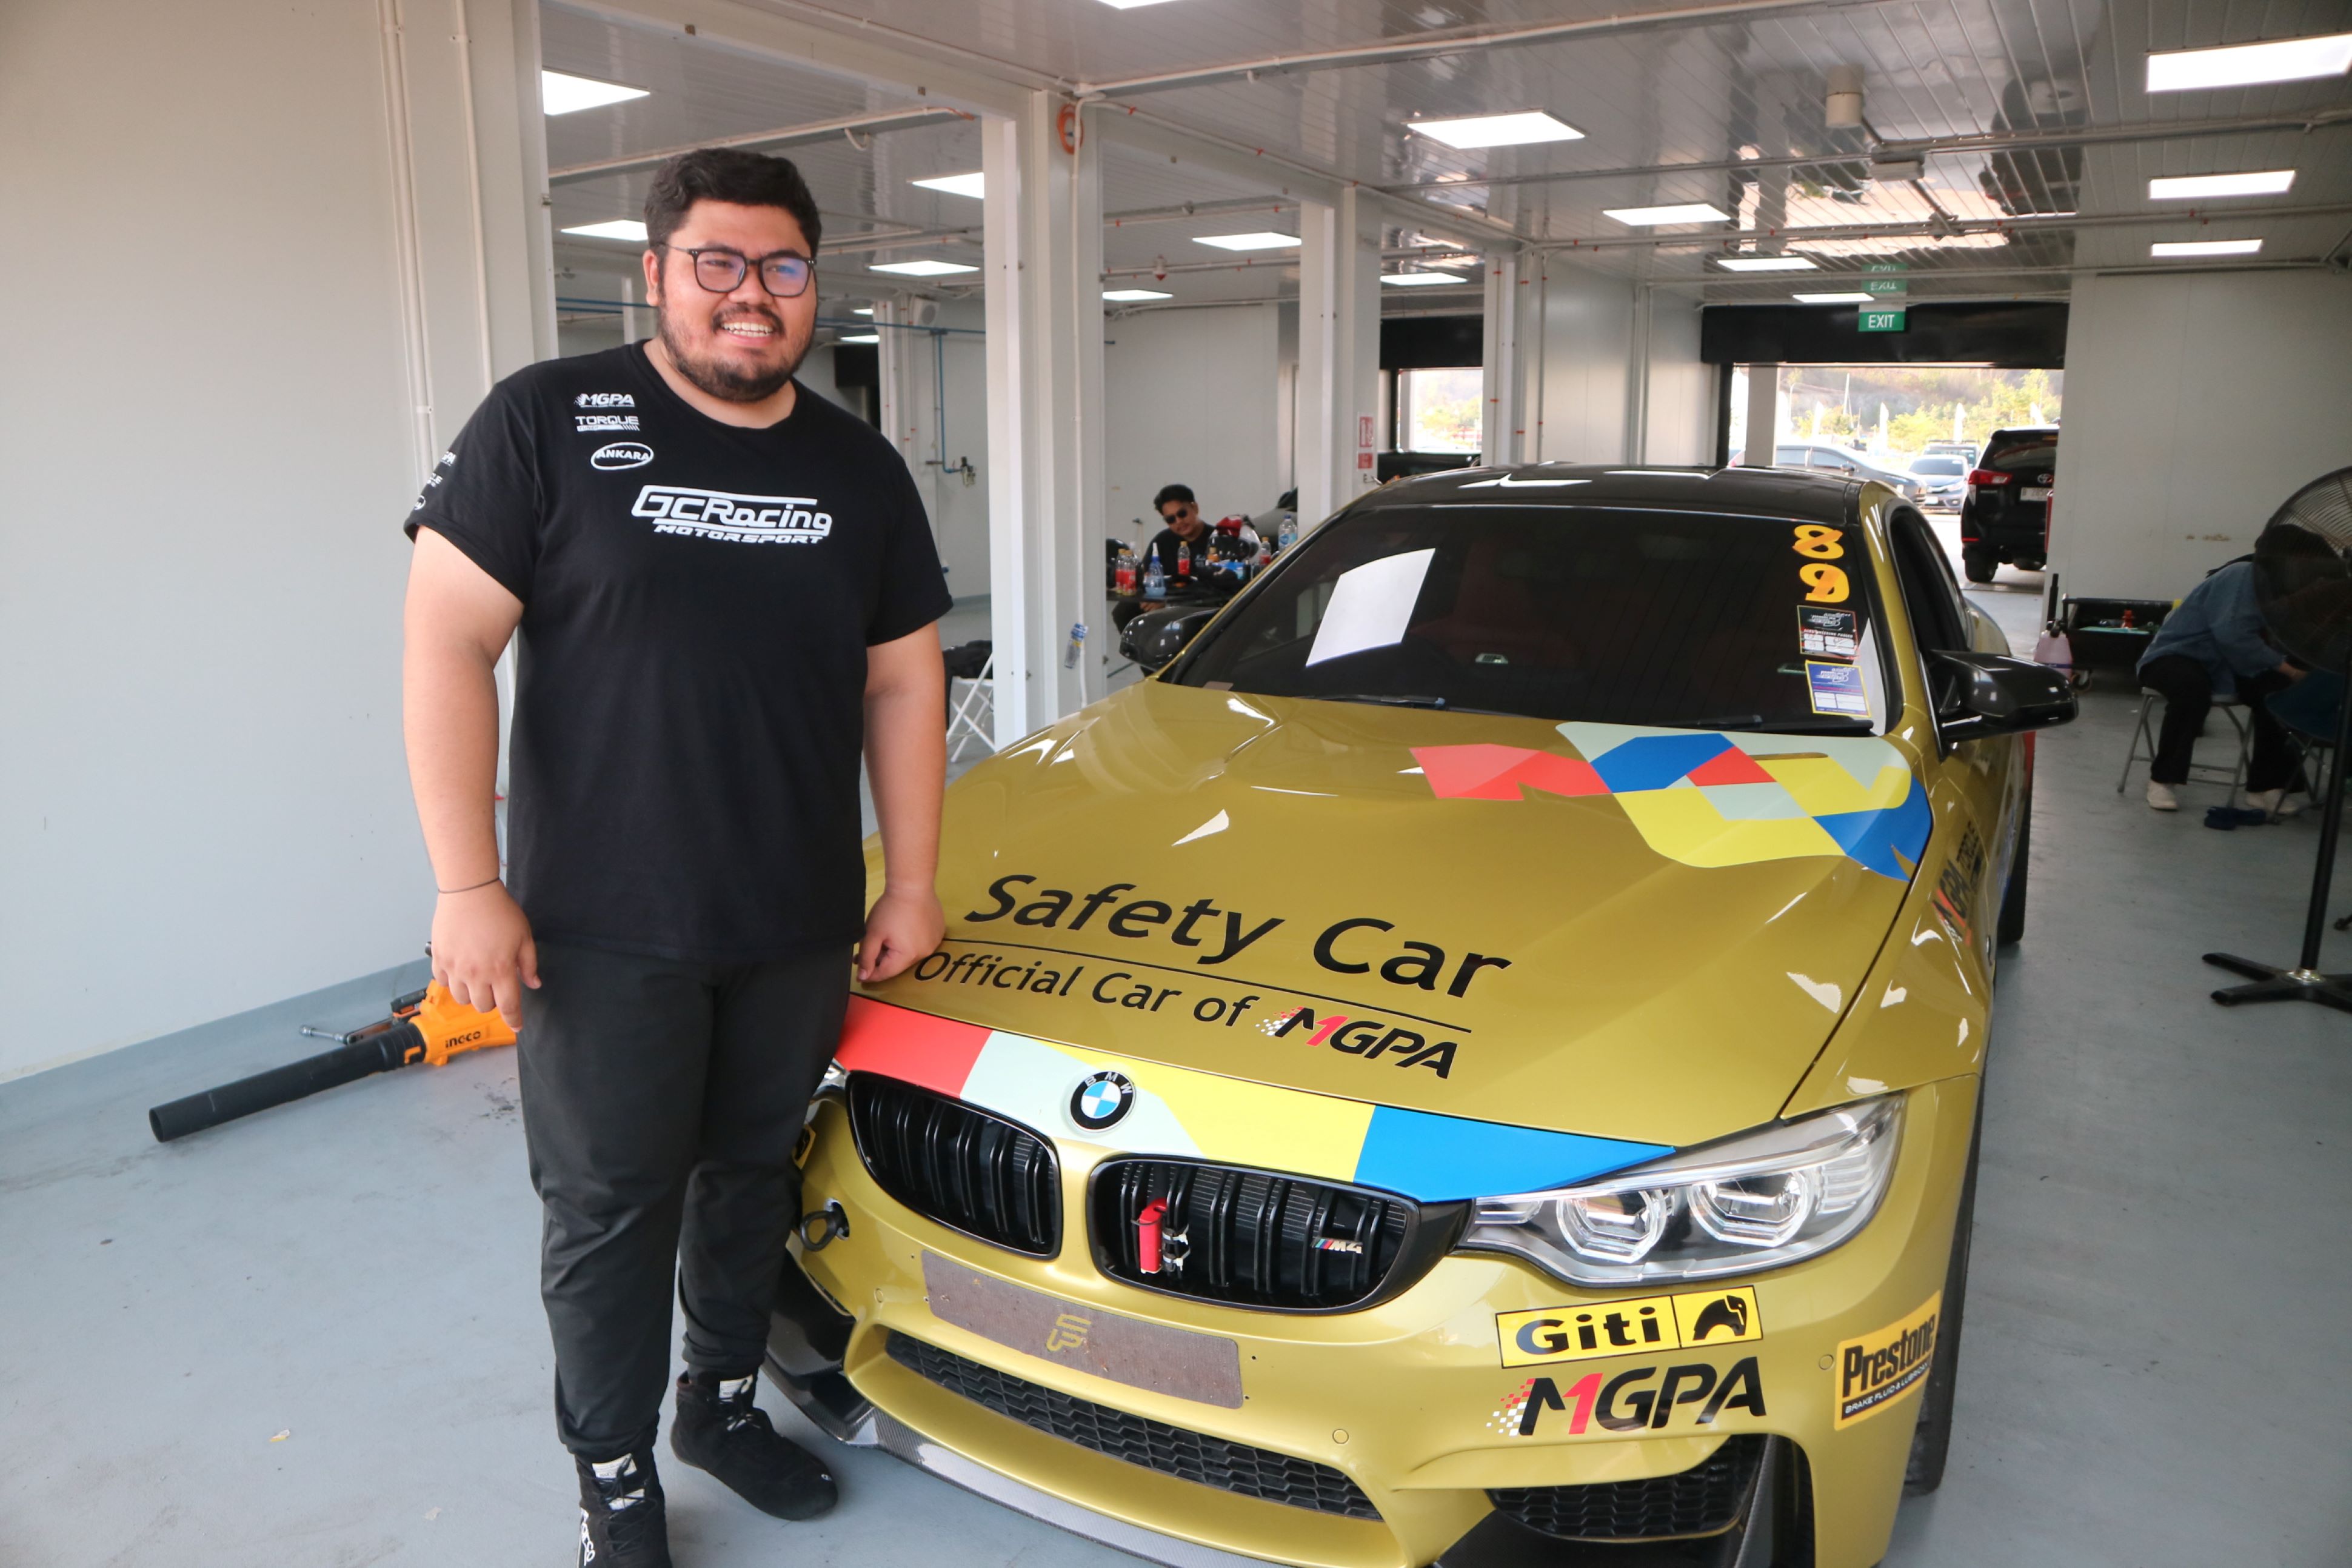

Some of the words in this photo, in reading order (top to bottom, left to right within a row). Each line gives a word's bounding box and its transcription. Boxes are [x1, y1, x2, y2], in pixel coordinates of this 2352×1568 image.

[1868, 314, 1895, 328] EXIT
[575, 415, 640, 425] TORQUE
[596, 449, 649, 460] ANKARA
[654, 525, 823, 544] MOTORSPORT
[964, 875, 1285, 965] Safety
[1312, 917, 1512, 998] Car
[914, 952, 1083, 996] Official
[1091, 972, 1181, 1013] Car
[1194, 995, 1260, 1027] of
[1084, 1072, 1133, 1094] BMW
[1328, 1240, 1362, 1254] M4
[1516, 1307, 1661, 1355] Giti
[1842, 1314, 1936, 1398] Prestone
[1845, 1396, 1873, 1413] BRAKE
[1874, 1385, 1895, 1402] FLUID
